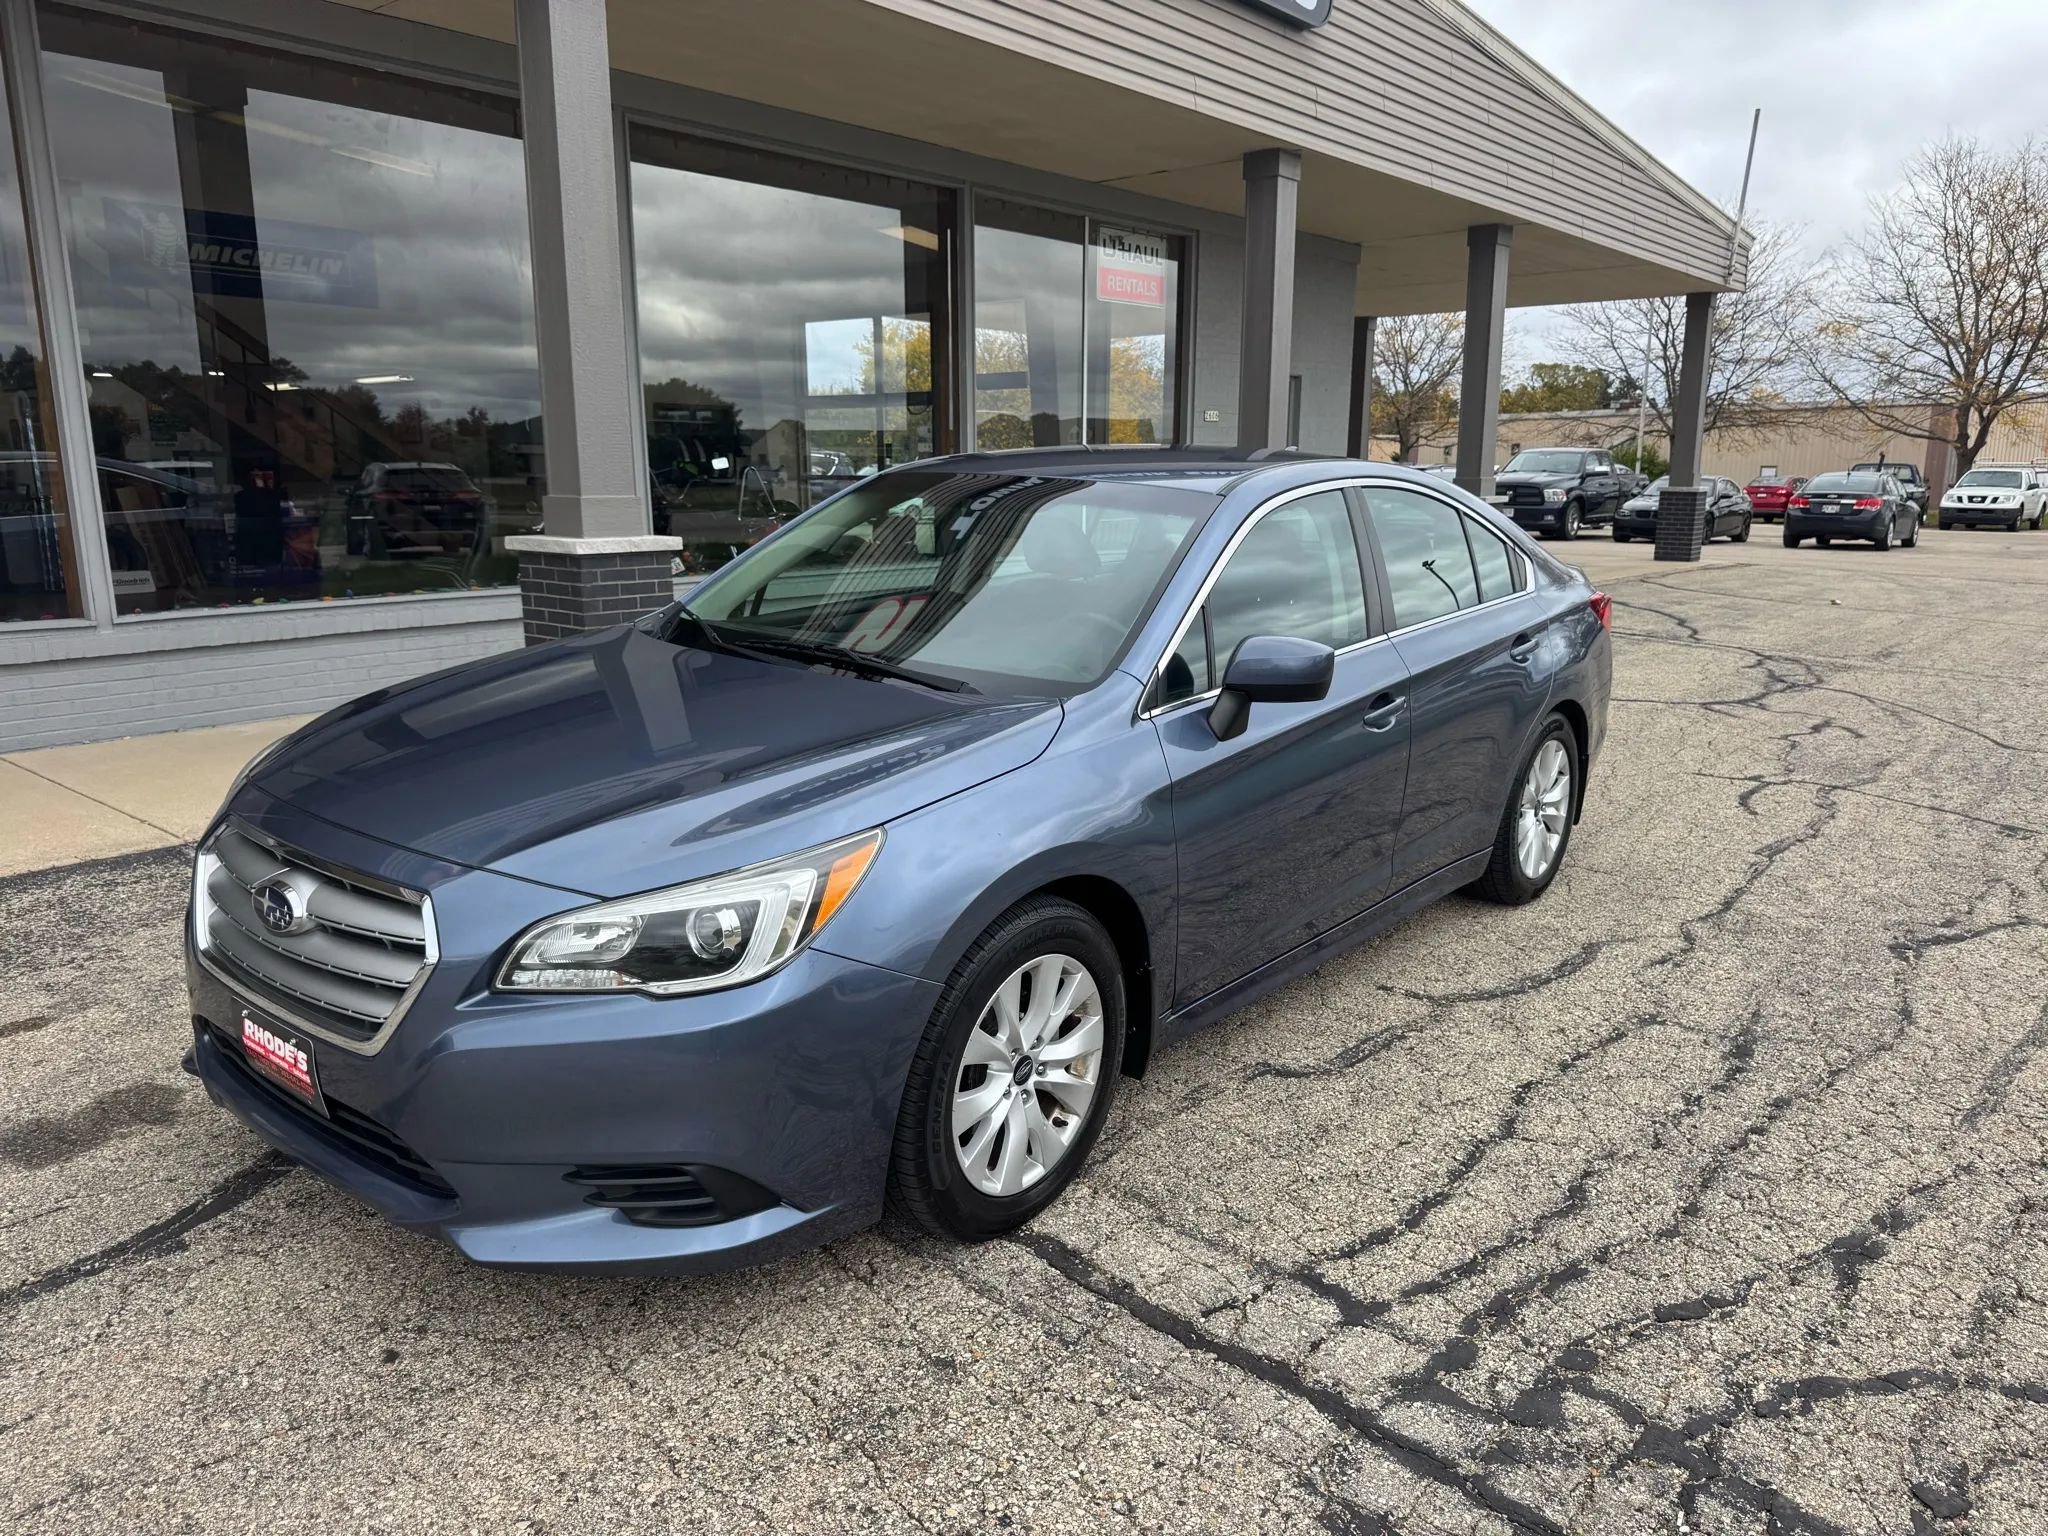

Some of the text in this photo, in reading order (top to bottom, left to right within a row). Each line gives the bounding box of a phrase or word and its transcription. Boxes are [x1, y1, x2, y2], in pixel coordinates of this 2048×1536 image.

[190, 242, 343, 275] MICHELIN
[1107, 275, 1158, 297] RENTALS
[244, 1018, 308, 1072] RHODE'S
